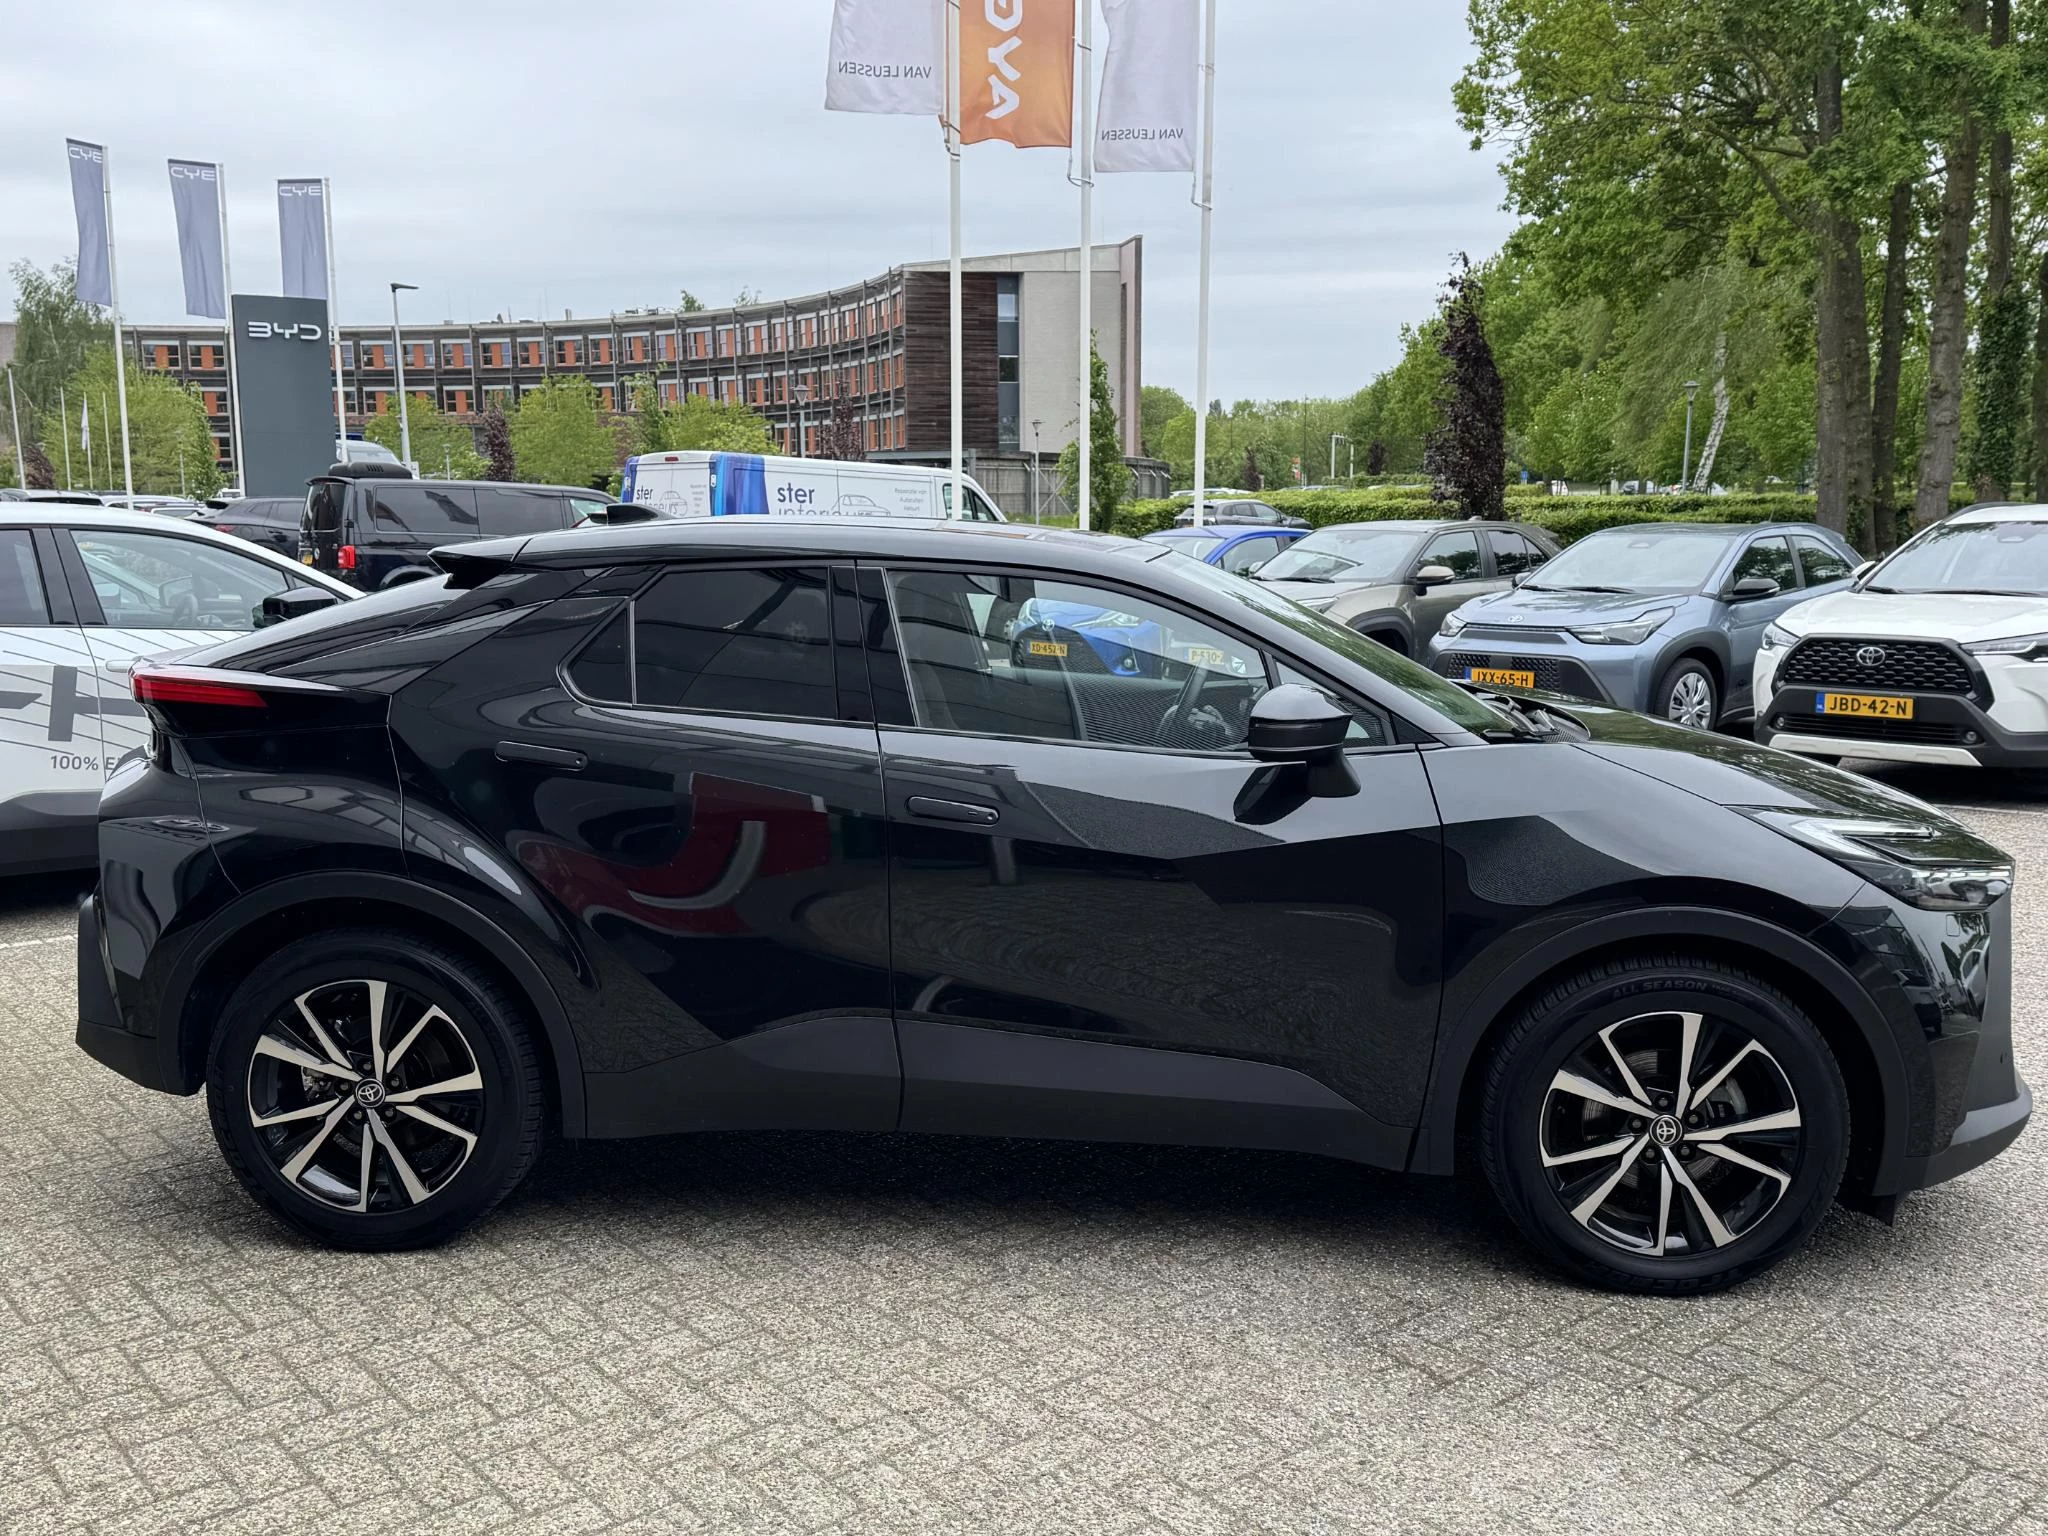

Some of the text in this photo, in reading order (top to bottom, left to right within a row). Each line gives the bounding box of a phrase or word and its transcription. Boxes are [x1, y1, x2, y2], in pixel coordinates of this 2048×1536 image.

[248, 321, 322, 341] BYD
[636, 484, 654, 500] ster
[777, 482, 815, 504] ster
[1829, 696, 1908, 716] JBD-42-N
[50, 755, 121, 771] 100% E
[1642, 980, 1708, 991] SEASON
